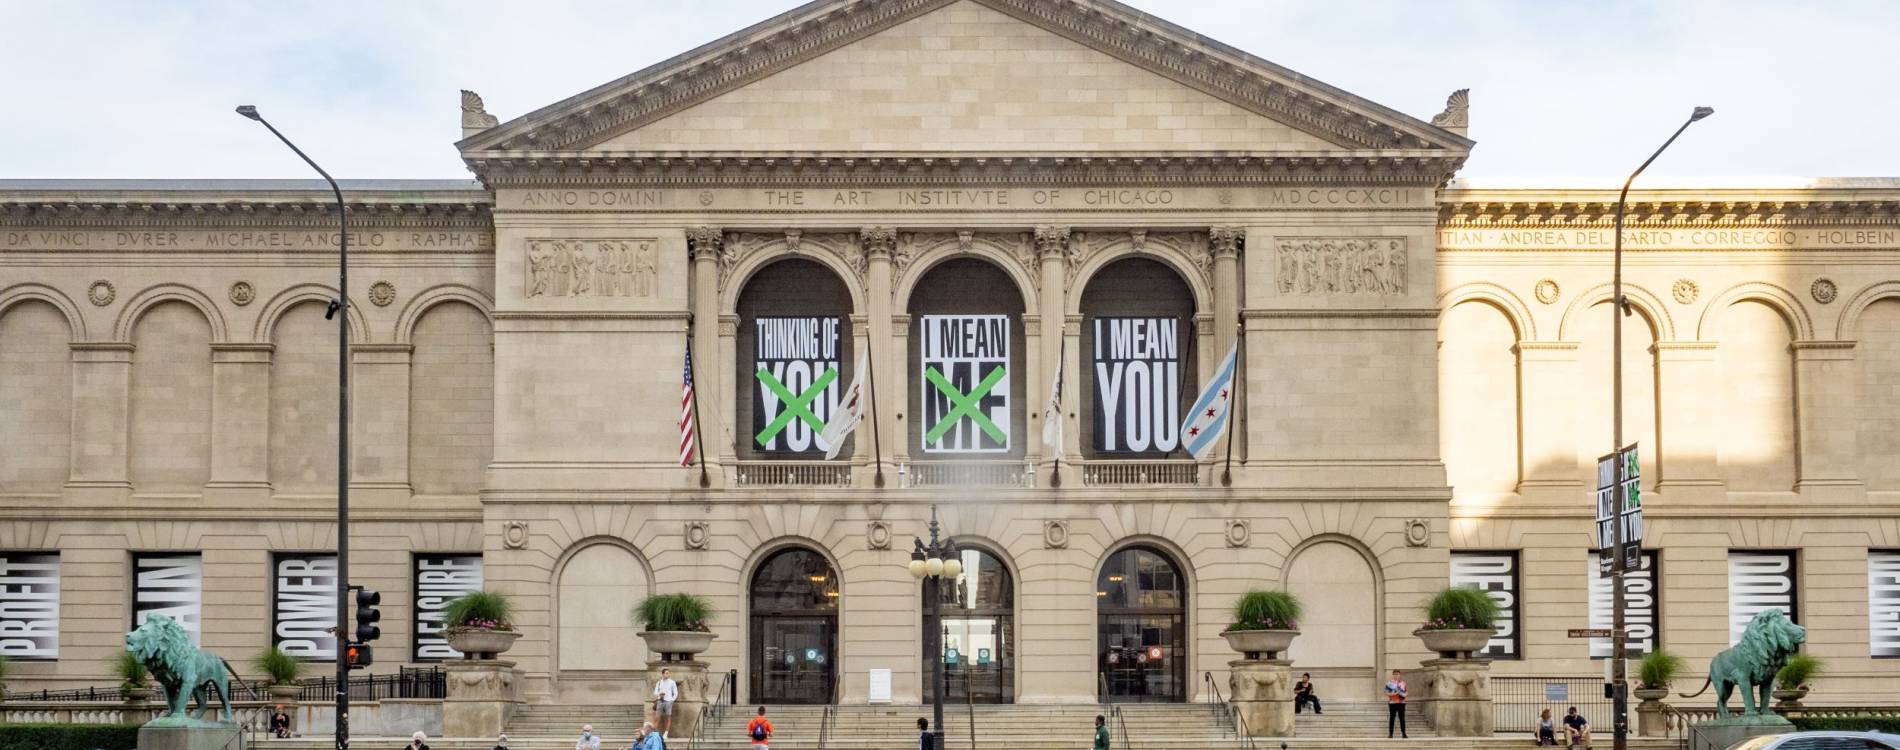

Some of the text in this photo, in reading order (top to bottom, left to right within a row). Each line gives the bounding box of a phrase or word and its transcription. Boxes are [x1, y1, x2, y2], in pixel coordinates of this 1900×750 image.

[522, 191, 664, 206] ANNO DOMINI
[764, 190, 1174, 205] THE ART INSTITVTE OF CHICAGO
[1271, 189, 1410, 204] MDCCCXCII
[7, 232, 90, 246] DA VINCI
[117, 232, 178, 246] DVRER
[205, 232, 292, 247] MICHAEL
[1435, 231, 1483, 246] ITIAN
[1500, 231, 1672, 246] ANDREA DEL SARTO
[1691, 231, 1796, 245] CORREGGIO
[1817, 231, 1894, 245] HOLBEIN
[756, 317, 839, 359] THINKING OF
[925, 318, 1006, 358] I MEAN
[1095, 318, 1178, 360] I MEAN
[756, 360, 839, 452] YOU
[925, 361, 1007, 450] ME
[1095, 360, 1179, 453] YOU
[0, 557, 59, 656] PROFIT
[137, 557, 201, 640] AIN
[277, 558, 339, 657] POWER
[1728, 555, 1791, 645] DOU
